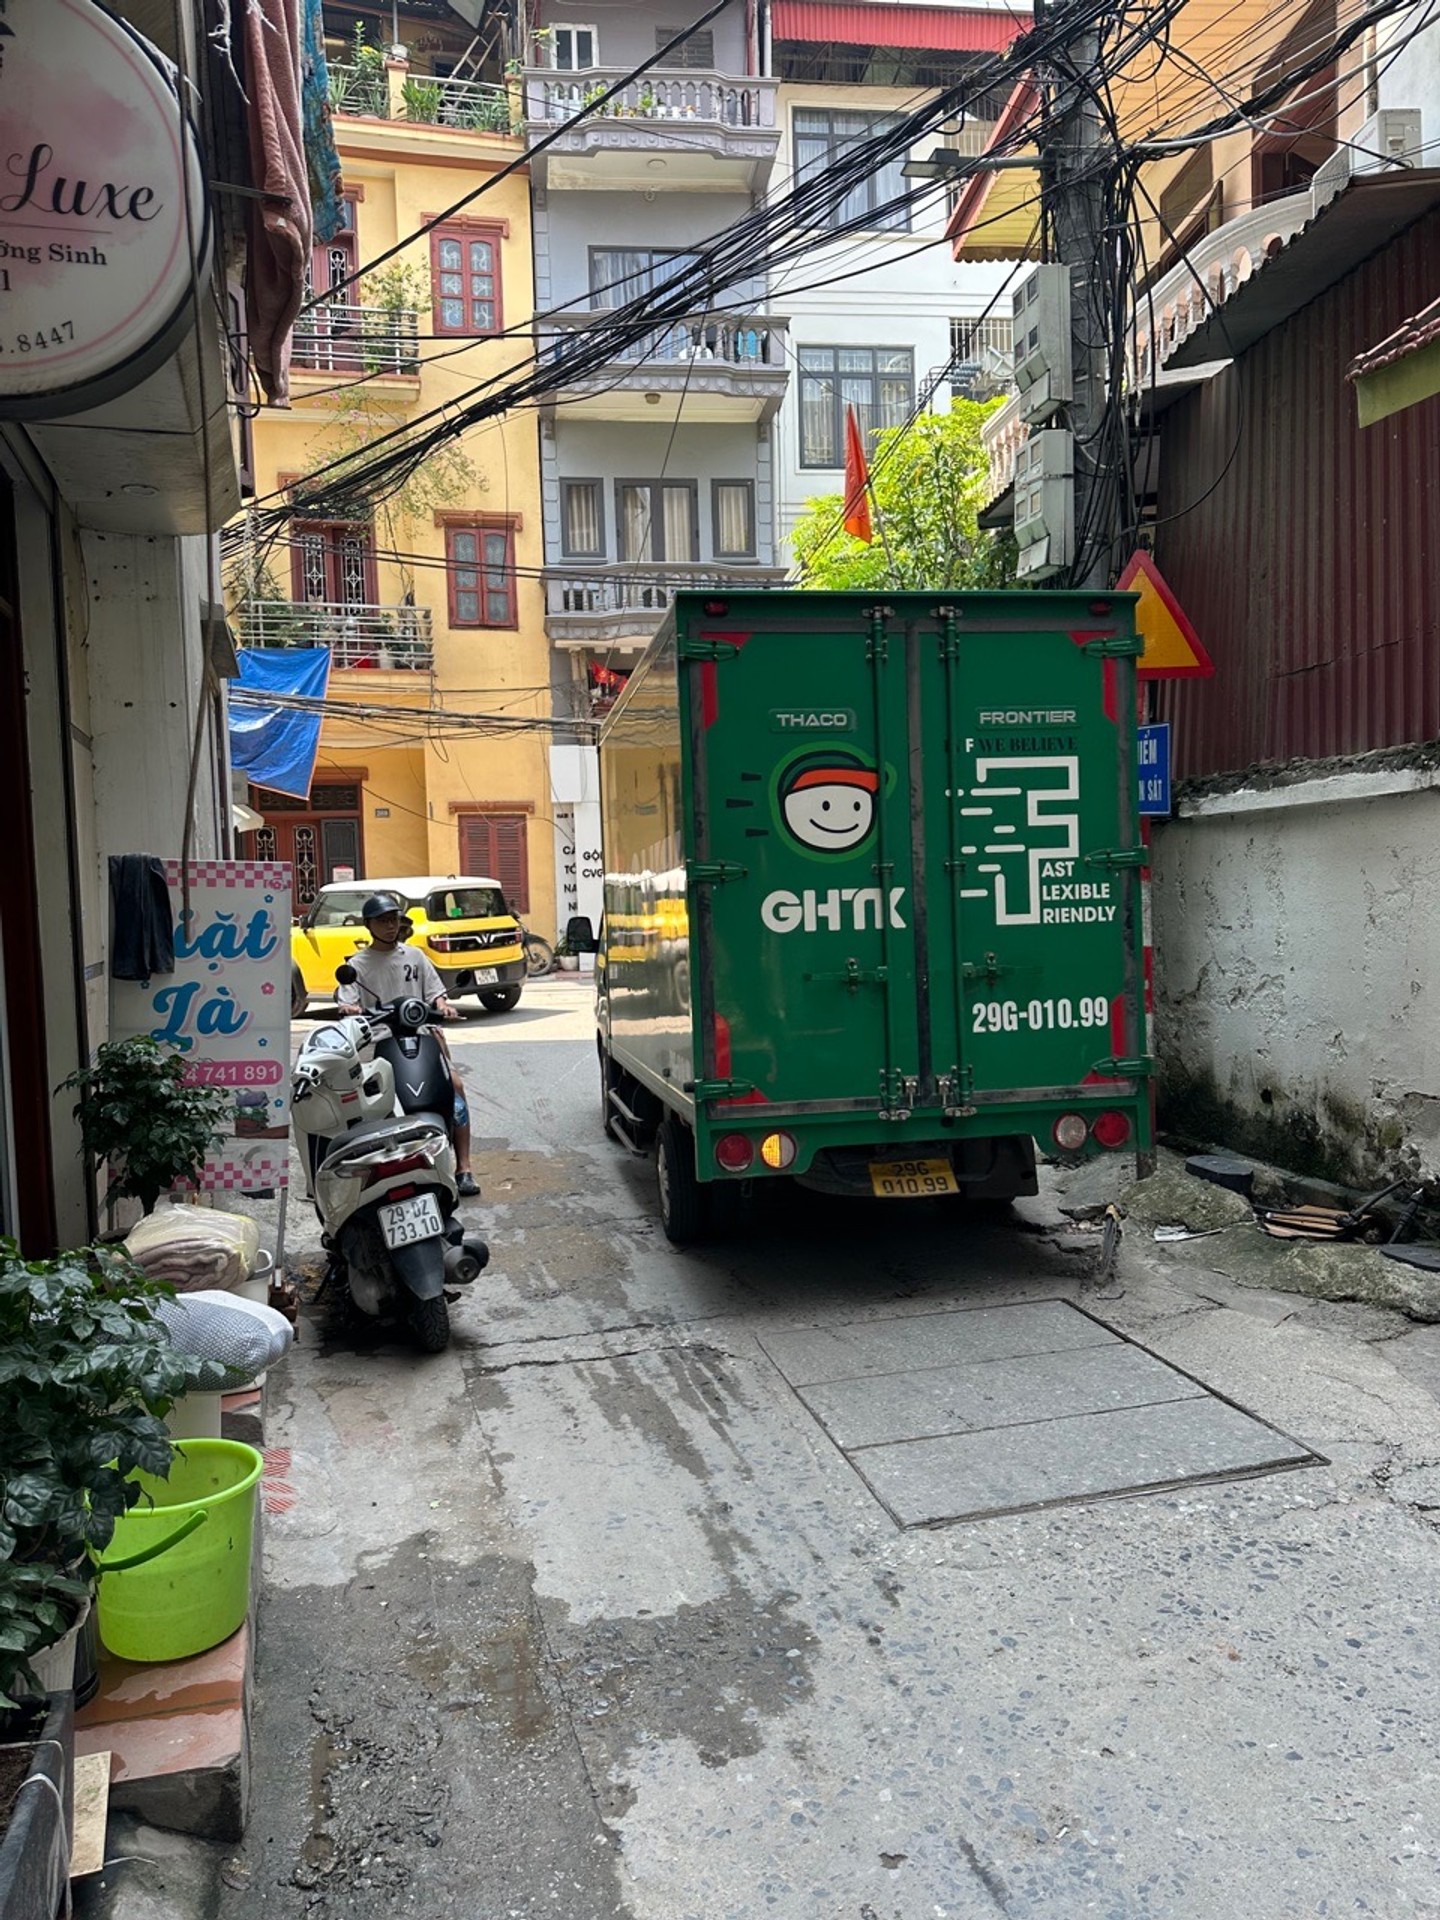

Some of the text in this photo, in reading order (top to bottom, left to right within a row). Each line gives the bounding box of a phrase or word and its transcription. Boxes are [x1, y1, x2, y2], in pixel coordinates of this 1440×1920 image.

[0, 142, 163, 222] Luxe
[48, 242, 107, 265] Sinh
[0, 320, 75, 353] .8447
[776, 713, 848, 727] THACO
[979, 710, 1077, 725] FRONTIER
[1010, 736, 1077, 752] BELIEVE
[1041, 861, 1075, 878] AST
[1042, 883, 1110, 901] LEXIBLE
[761, 886, 907, 934] GHTK
[1043, 906, 1116, 924] RIENDLY
[174, 909, 277, 971] iặt
[151, 981, 248, 1053] Là
[972, 996, 1108, 1033] 29G-010.99
[203, 1066, 237, 1081] 741
[244, 1065, 278, 1080] 891
[892, 1161, 929, 1177] 29G
[882, 1176, 949, 1194] 010.99
[387, 1215, 440, 1246] 733.10
